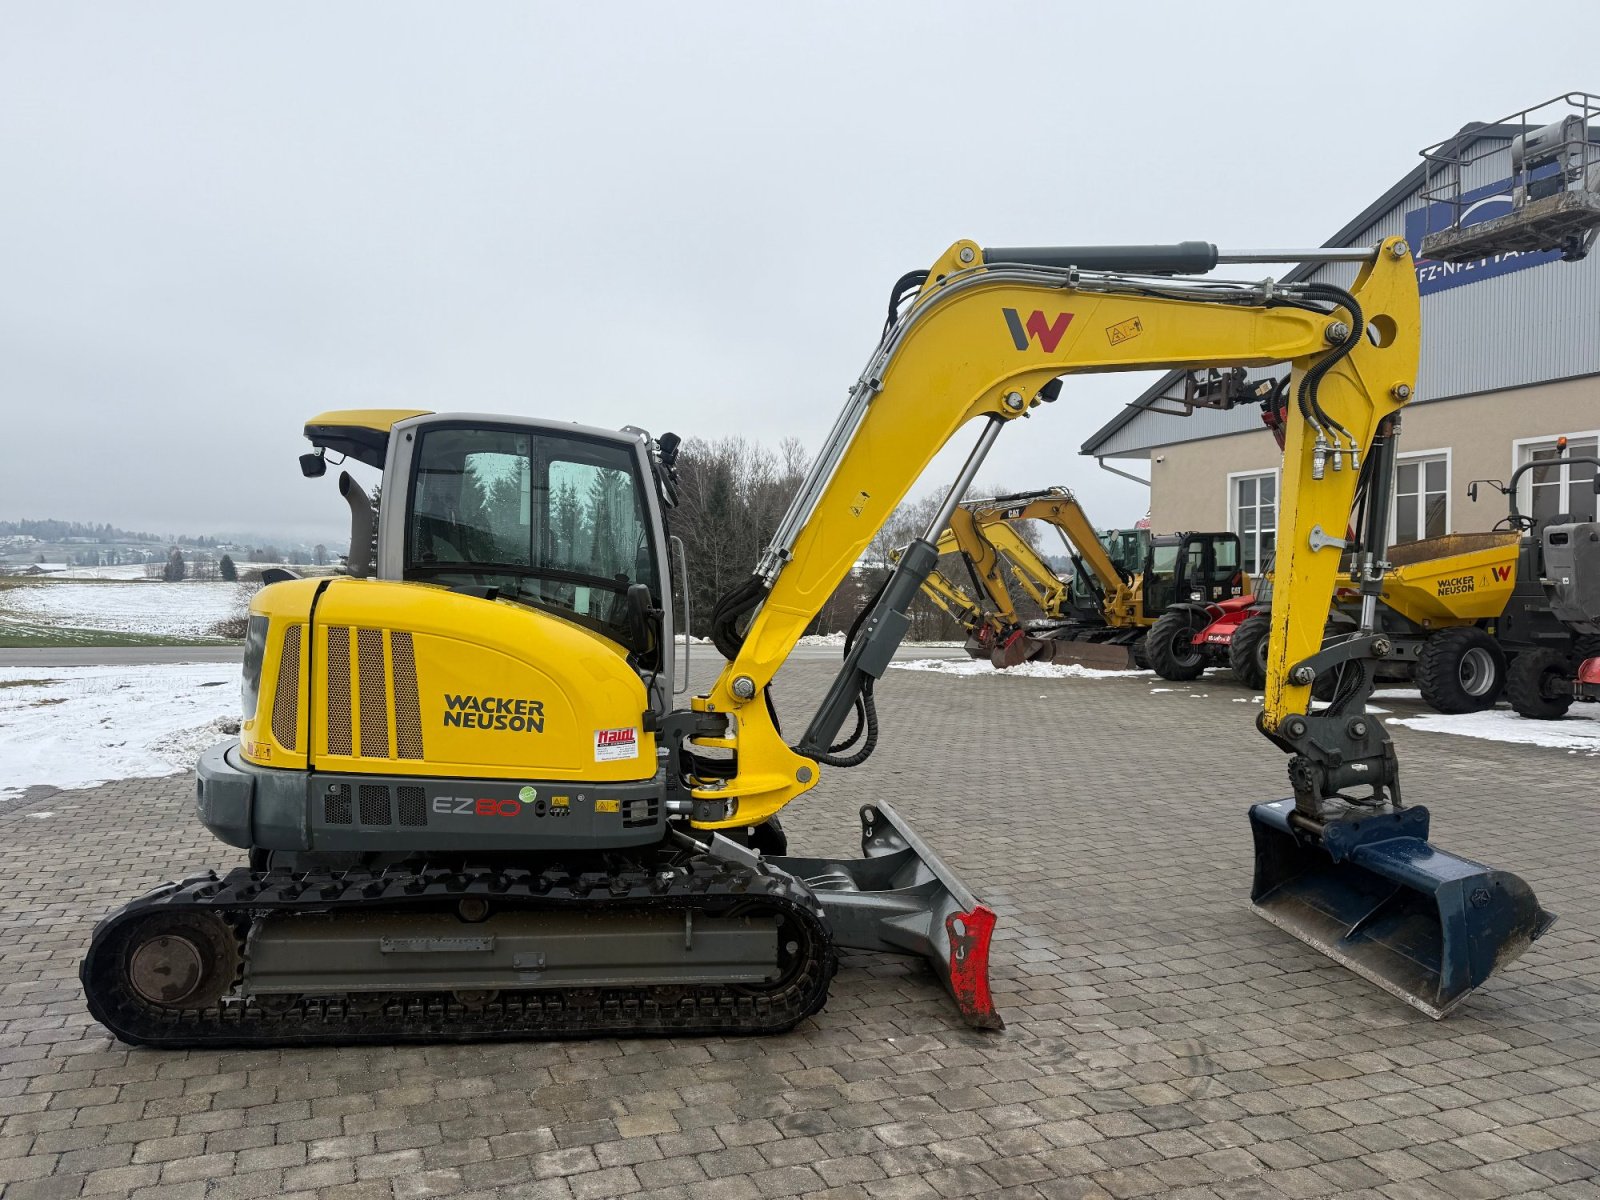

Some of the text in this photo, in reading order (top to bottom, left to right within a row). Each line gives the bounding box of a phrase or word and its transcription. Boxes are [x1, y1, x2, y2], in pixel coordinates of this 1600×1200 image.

[1008, 509, 1020, 518] CAT
[1437, 575, 1475, 588] WACKER
[1437, 584, 1475, 597] NEUSON
[443, 693, 545, 717] WACKER
[443, 710, 545, 734] NEUSON
[432, 796, 522, 817] EZ80
